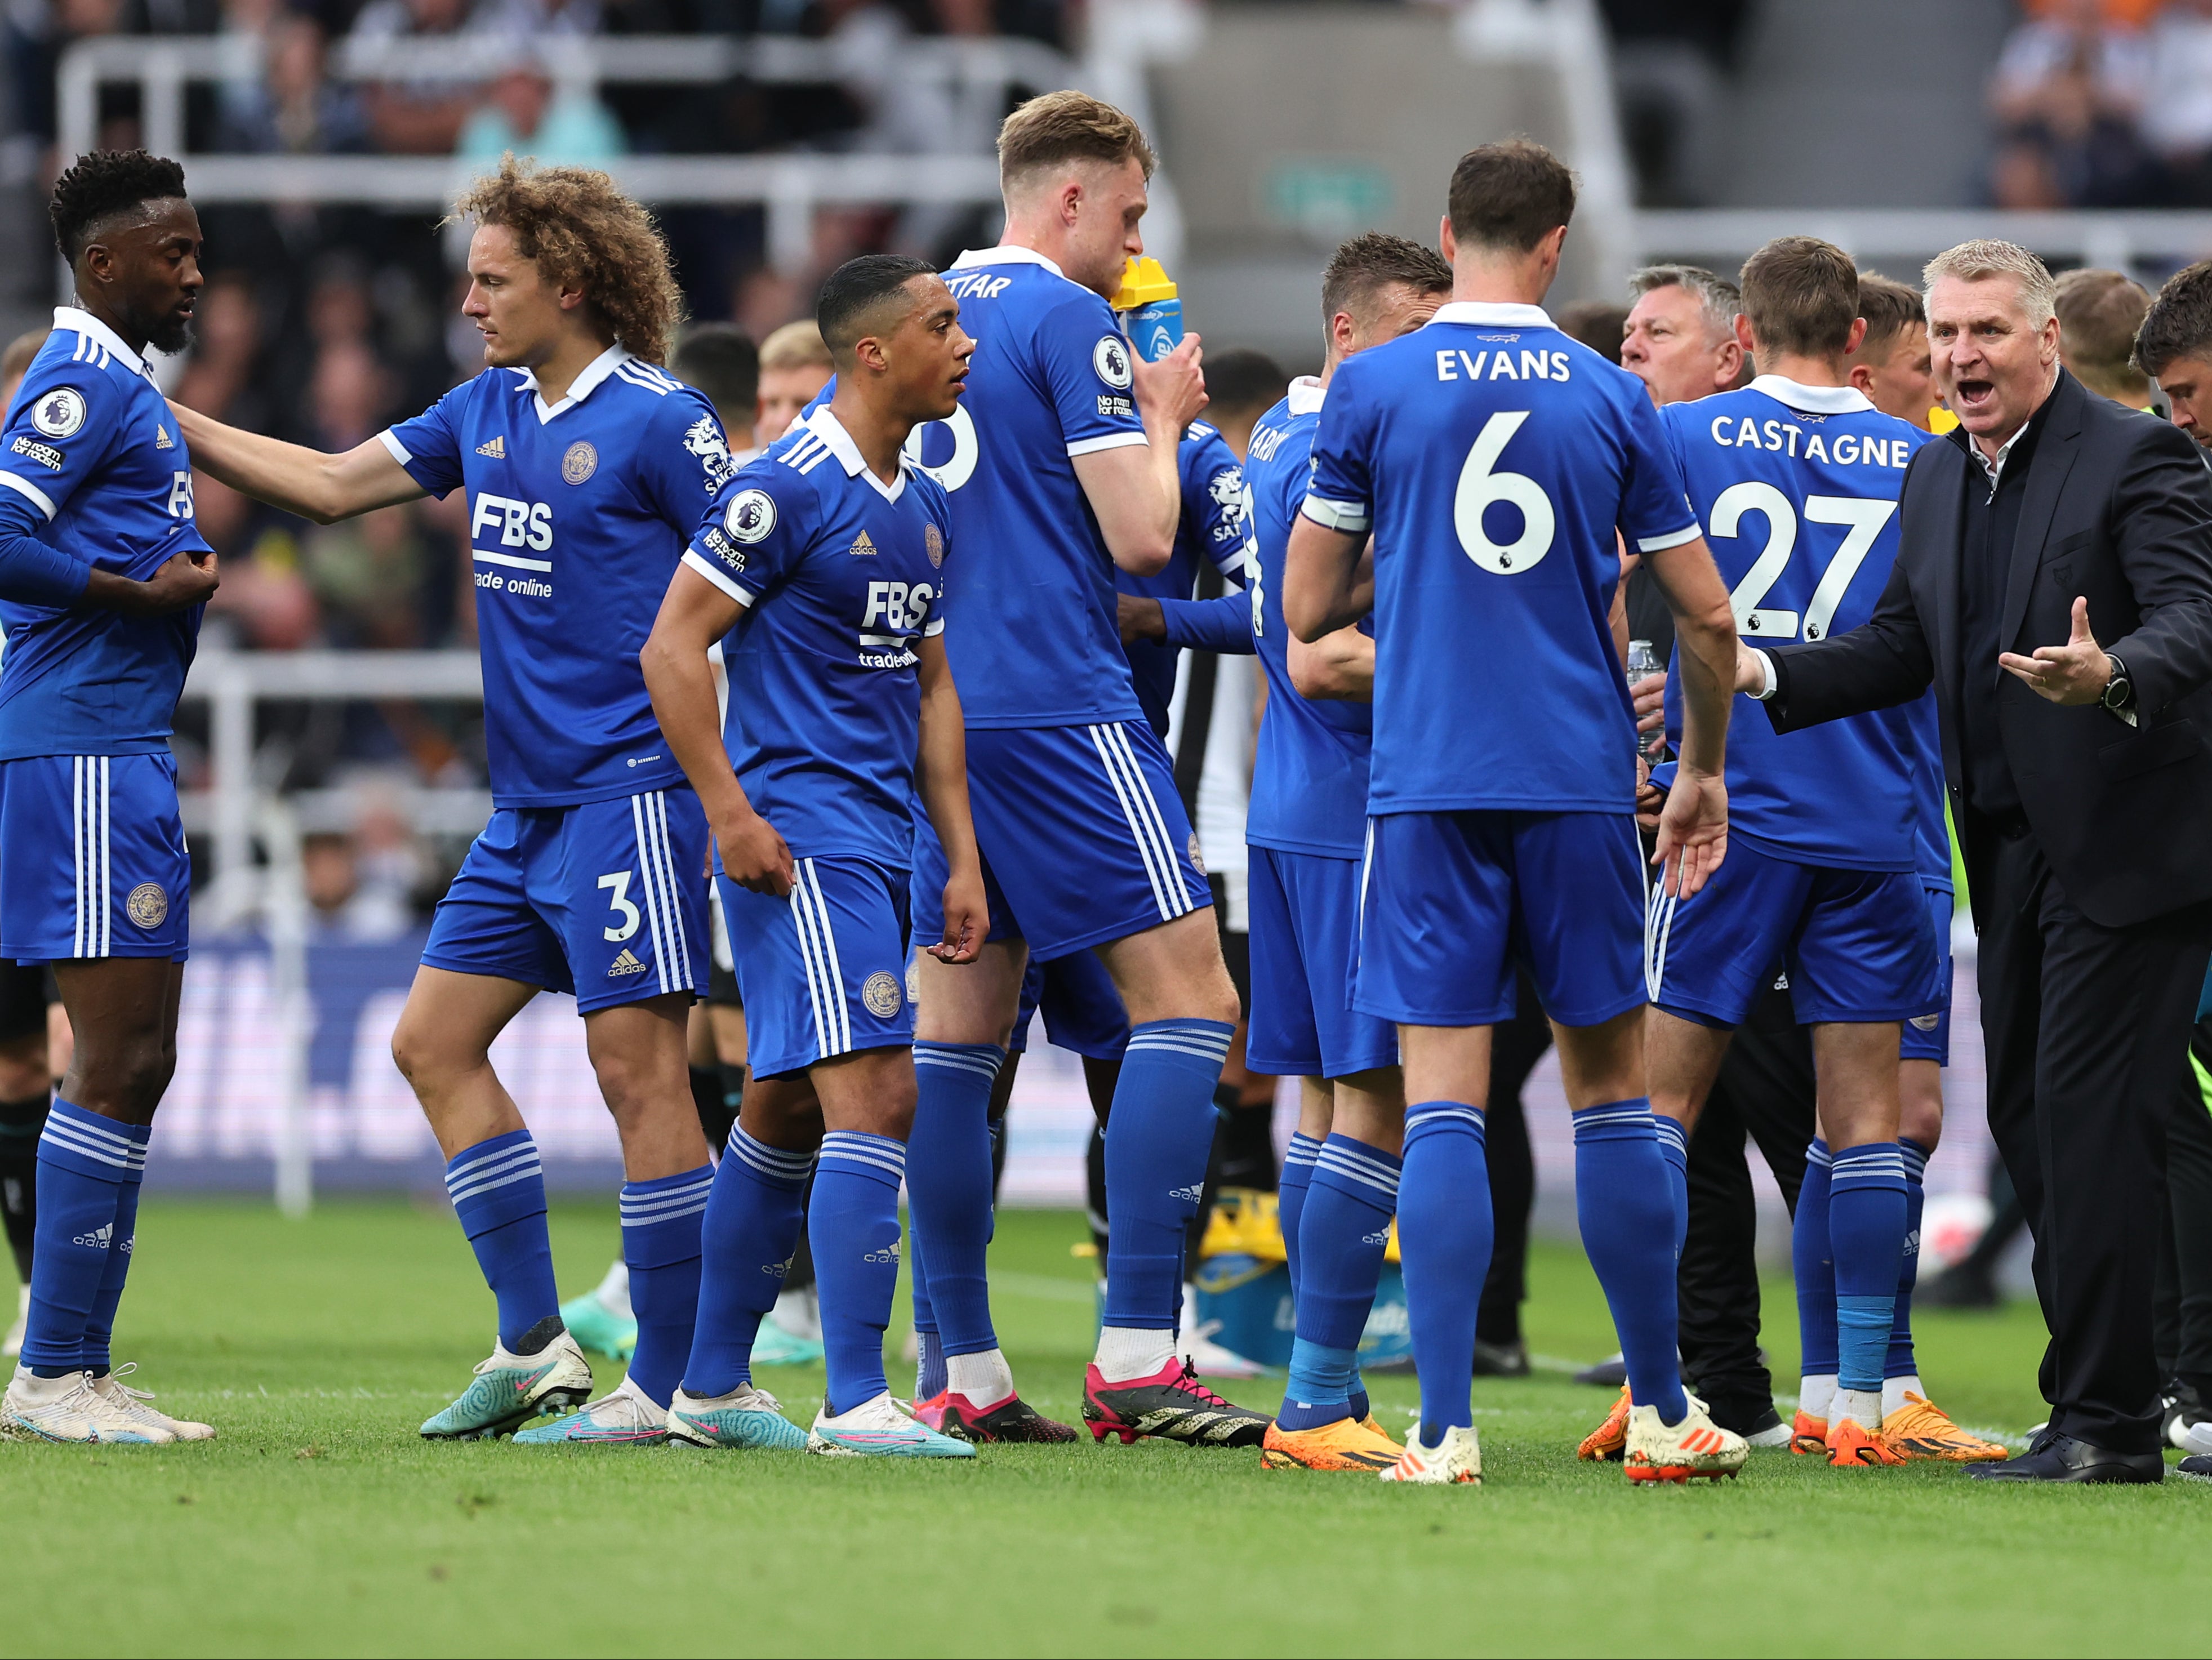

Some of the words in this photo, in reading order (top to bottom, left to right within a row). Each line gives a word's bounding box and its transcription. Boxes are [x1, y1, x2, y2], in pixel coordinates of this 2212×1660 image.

[1436, 349, 1570, 382] EVANS
[1097, 395, 1112, 406] No
[1114, 397, 1130, 408] room
[1098, 404, 1113, 415] for
[14, 437, 32, 447] No
[31, 442, 61, 462] room
[1711, 416, 1910, 468] CASTAGNE
[11, 443, 28, 455] for
[26, 449, 62, 472] racism
[475, 447, 506, 459] adidas
[1453, 410, 1556, 575] 6
[471, 492, 553, 551] FBS
[703, 535, 717, 549] for
[709, 528, 723, 544] No
[719, 541, 746, 563] room
[849, 545, 877, 555] adidas
[1710, 481, 1898, 643] 27
[474, 571, 504, 590] rade
[508, 578, 552, 598] online
[861, 581, 933, 629] FBS
[858, 651, 902, 668] trade
[598, 871, 640, 942] 3
[608, 963, 647, 977] adidas
[1169, 1190, 1201, 1204] adid
[73, 1236, 110, 1249] adid
[1362, 1235, 1388, 1246] adi
[864, 1253, 900, 1263] adid
